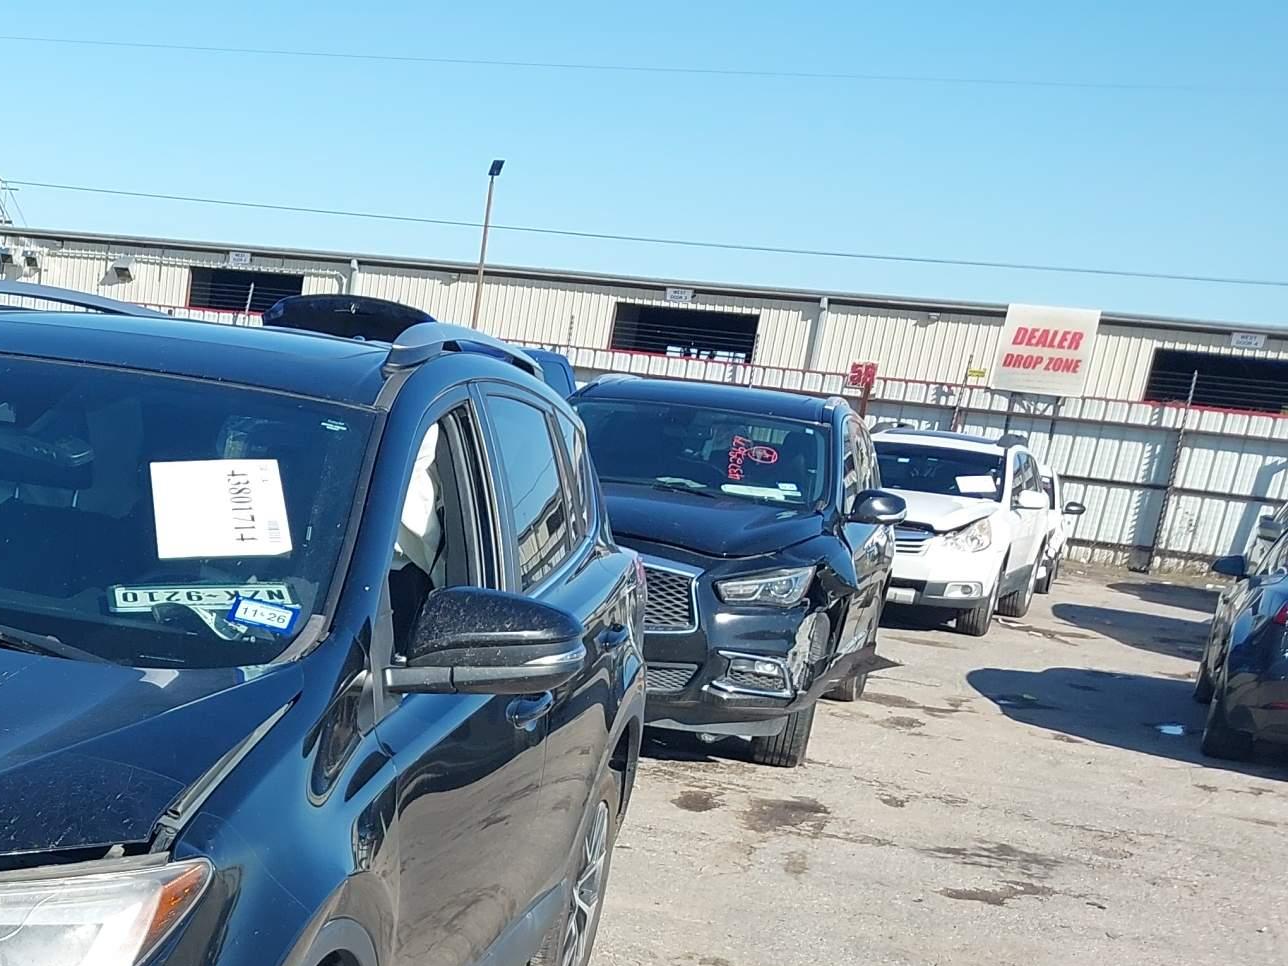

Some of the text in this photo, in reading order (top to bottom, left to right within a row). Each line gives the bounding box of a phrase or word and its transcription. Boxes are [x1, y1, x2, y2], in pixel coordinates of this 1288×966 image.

[1012, 327, 1084, 350] DEALER
[1002, 353, 1082, 373] DROP ZONE
[227, 470, 258, 541] 43801714
